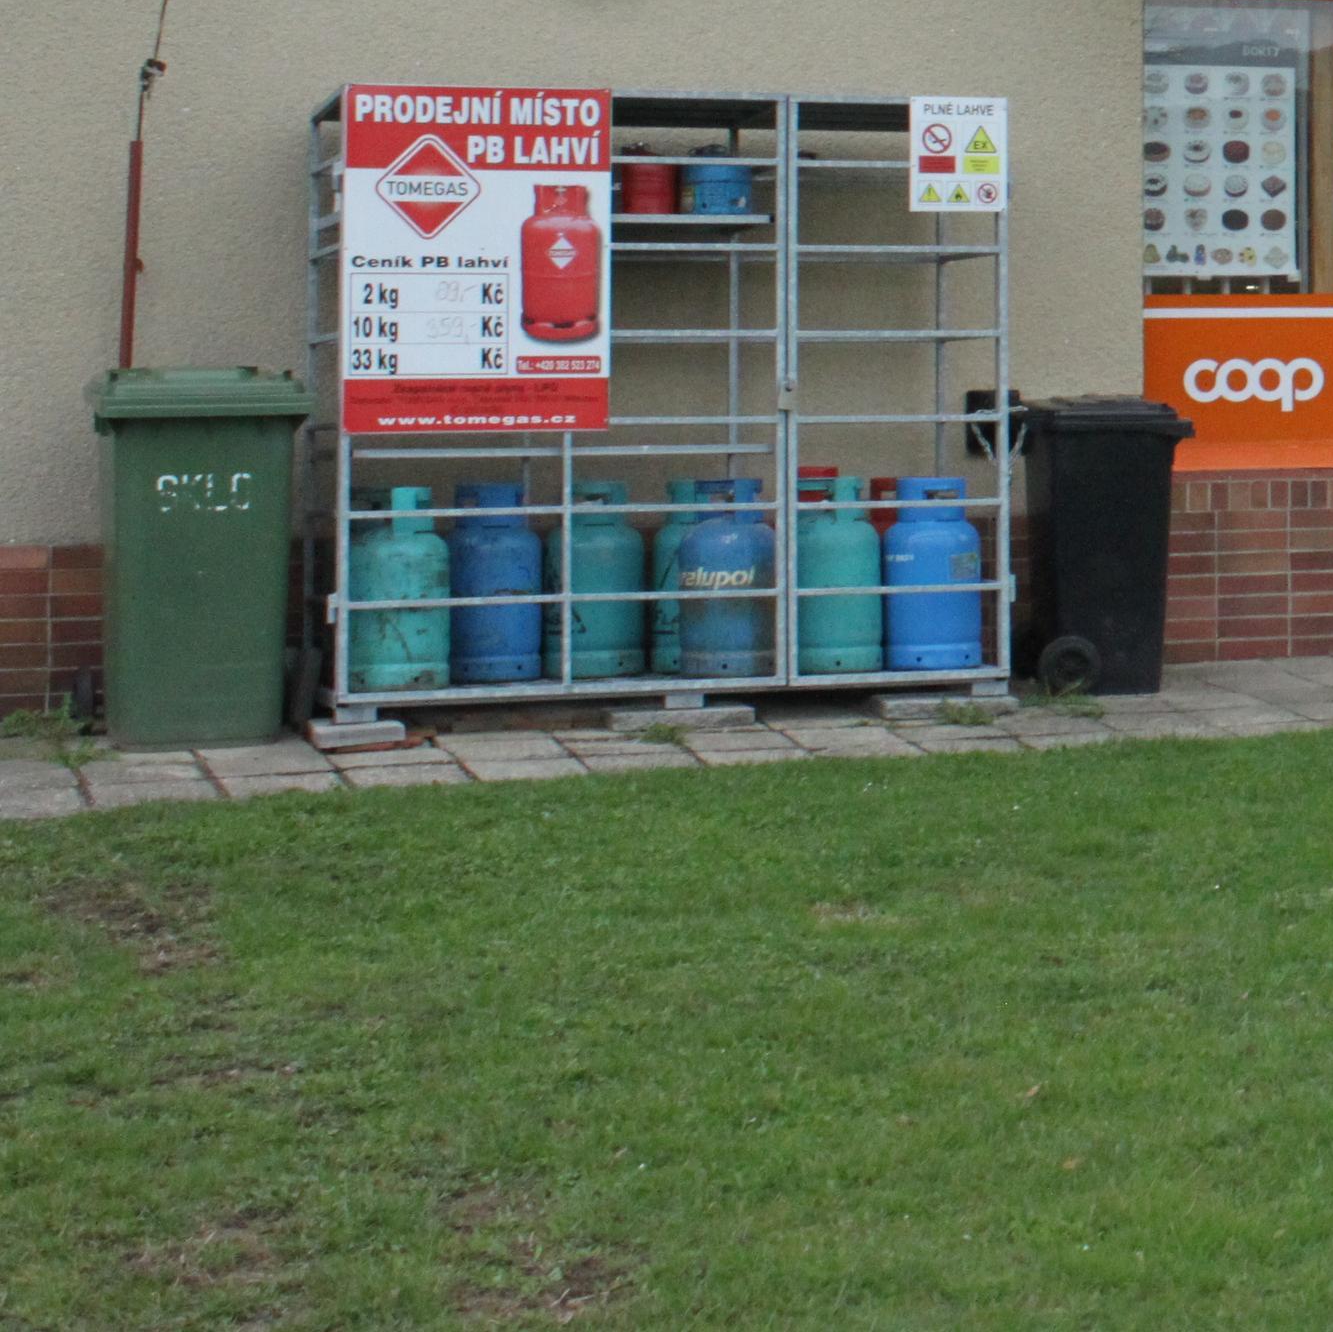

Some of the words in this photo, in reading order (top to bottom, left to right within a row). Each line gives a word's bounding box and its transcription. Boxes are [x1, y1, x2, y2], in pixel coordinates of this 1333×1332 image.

[354, 92, 503, 124] PRODEJNÍ
[510, 92, 601, 127] MÍSTO
[924, 102, 953, 115] PLNÉ
[957, 104, 994, 116] LAHVE
[467, 135, 505, 164] PB
[514, 131, 601, 166] LAHVÍ
[974, 141, 987, 150] EX
[386, 180, 468, 196] TOMEGAS
[351, 255, 413, 268] Ceník
[421, 256, 449, 268] PB
[458, 256, 510, 268] lahví
[363, 283, 373, 305] 2
[379, 282, 399, 309] kg
[481, 282, 504, 305] Kč
[353, 316, 373, 338] 10
[379, 316, 399, 342] kg
[481, 315, 504, 338] Kč
[352, 349, 373, 370] 33
[378, 348, 398, 375] kg
[481, 347, 504, 369] Kč
[1183, 357, 1325, 412] coop
[377, 414, 577, 427] www.tomegas.cz
